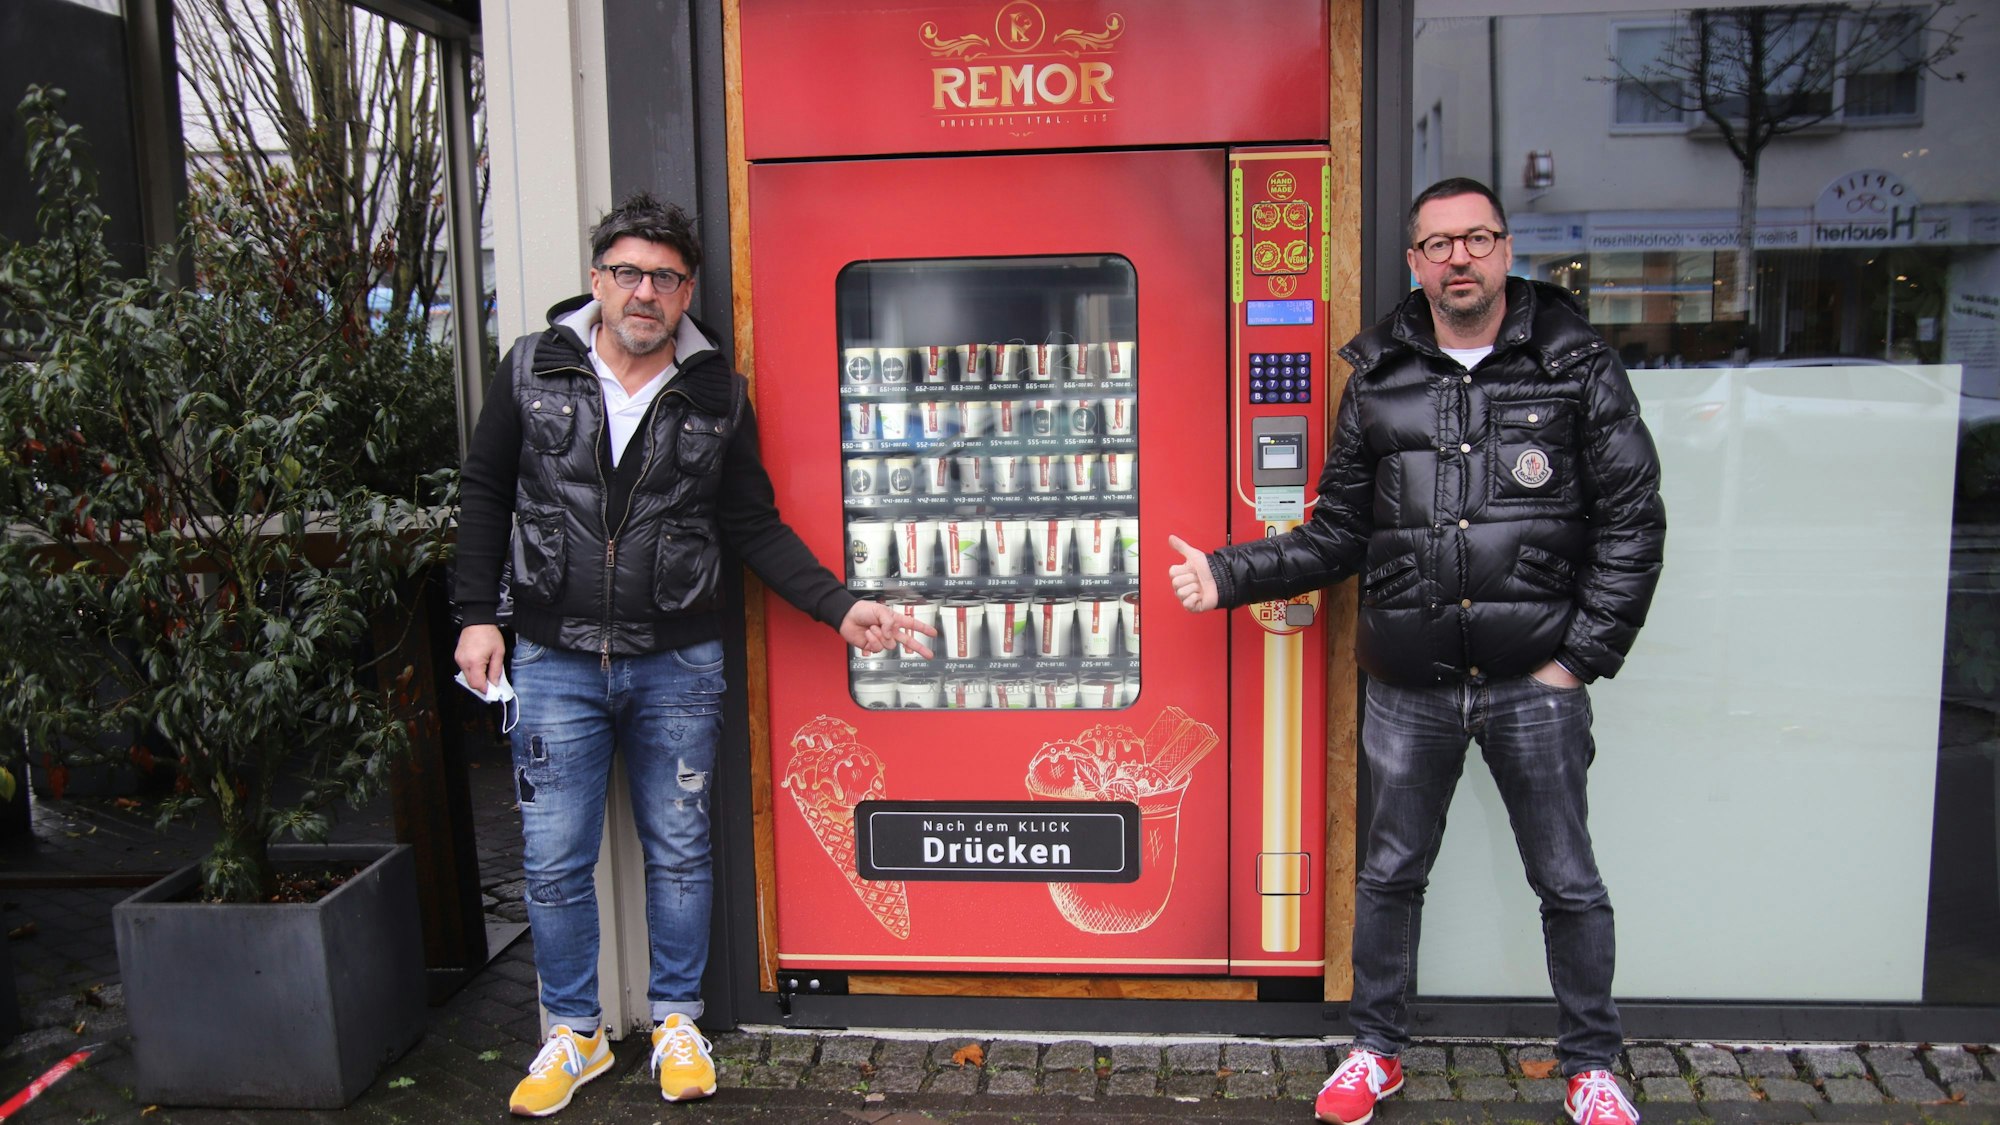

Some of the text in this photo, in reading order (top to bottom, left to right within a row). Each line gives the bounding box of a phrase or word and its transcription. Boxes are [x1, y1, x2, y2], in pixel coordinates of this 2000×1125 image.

[931, 62, 1115, 109] REMOR
[940, 114, 1107, 128] ORIGINAL ITAL. EIS
[923, 820, 1070, 833] Nach dem KLICK
[923, 836, 1071, 864] Drücken
